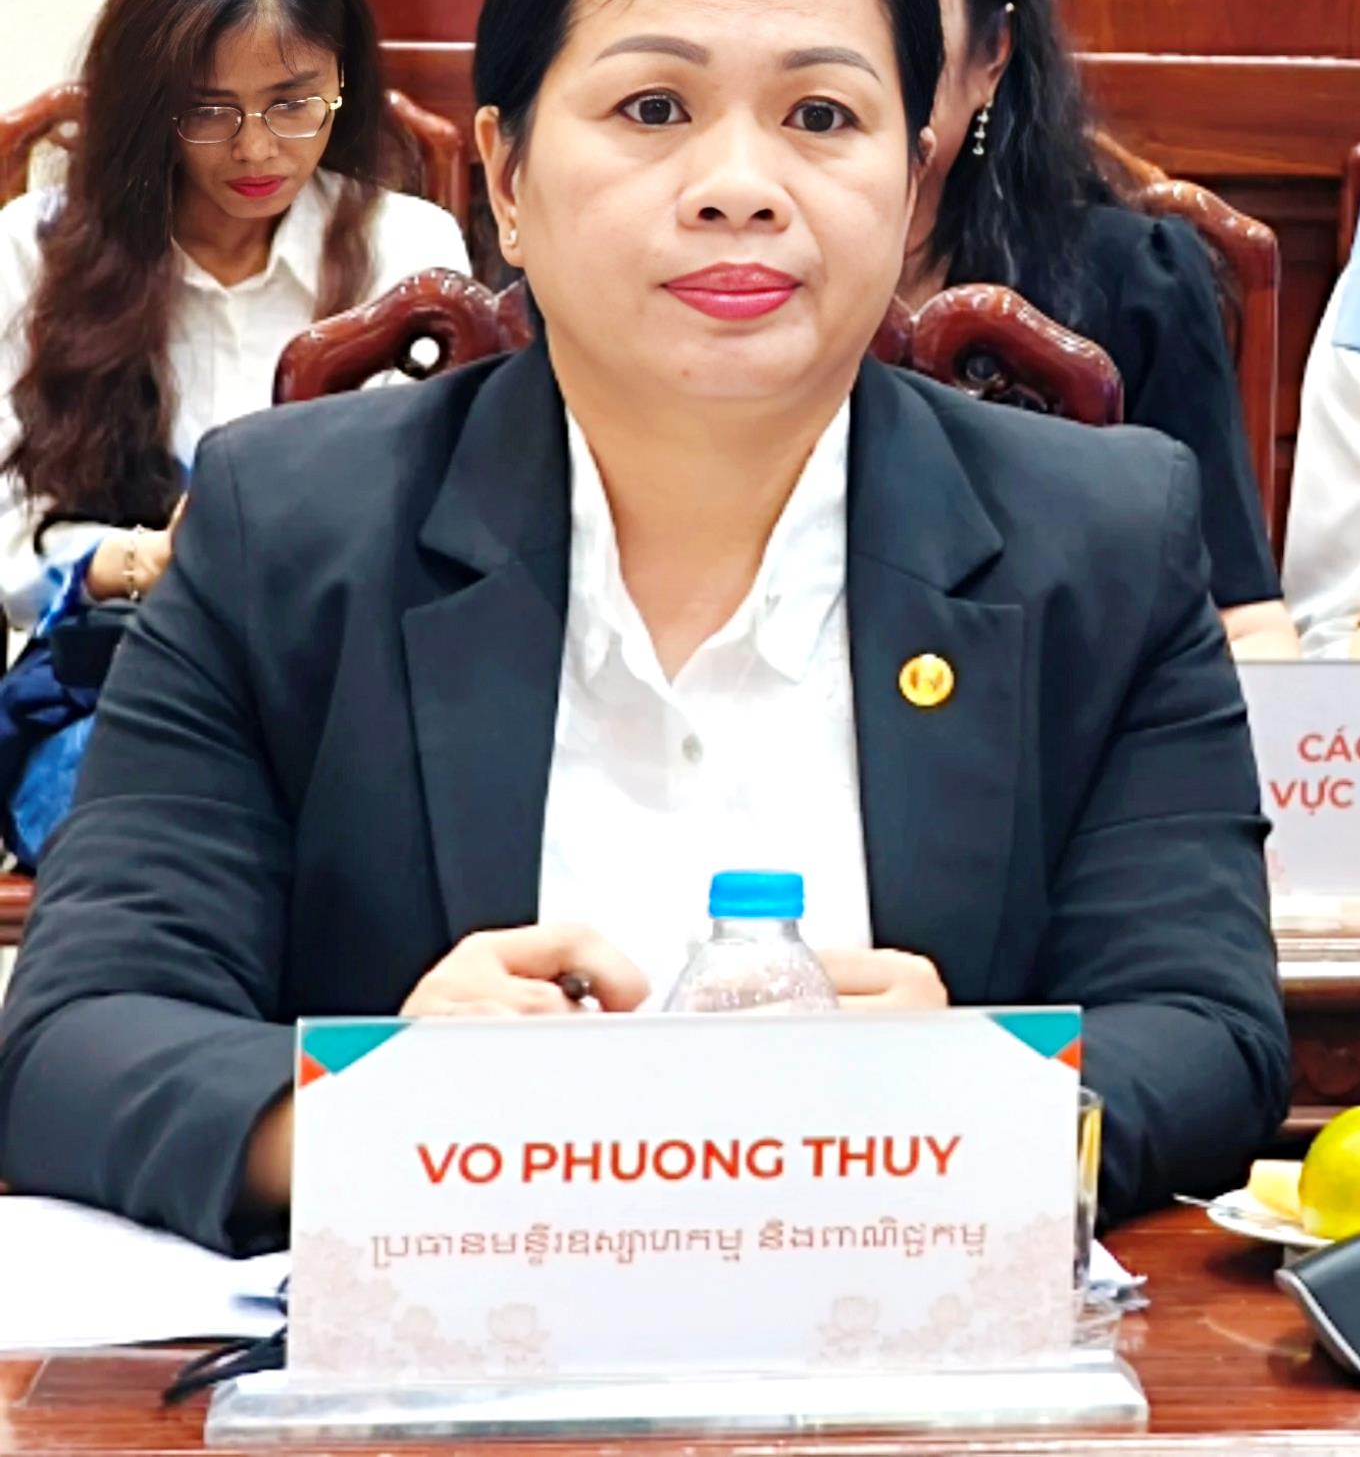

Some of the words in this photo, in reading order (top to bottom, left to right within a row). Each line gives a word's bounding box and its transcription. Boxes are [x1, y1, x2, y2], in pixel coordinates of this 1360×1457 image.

[1269, 775, 1355, 815] VỰC
[416, 1142, 503, 1185] VO
[521, 1137, 785, 1184] PHUONG
[801, 1135, 962, 1178] THUY
